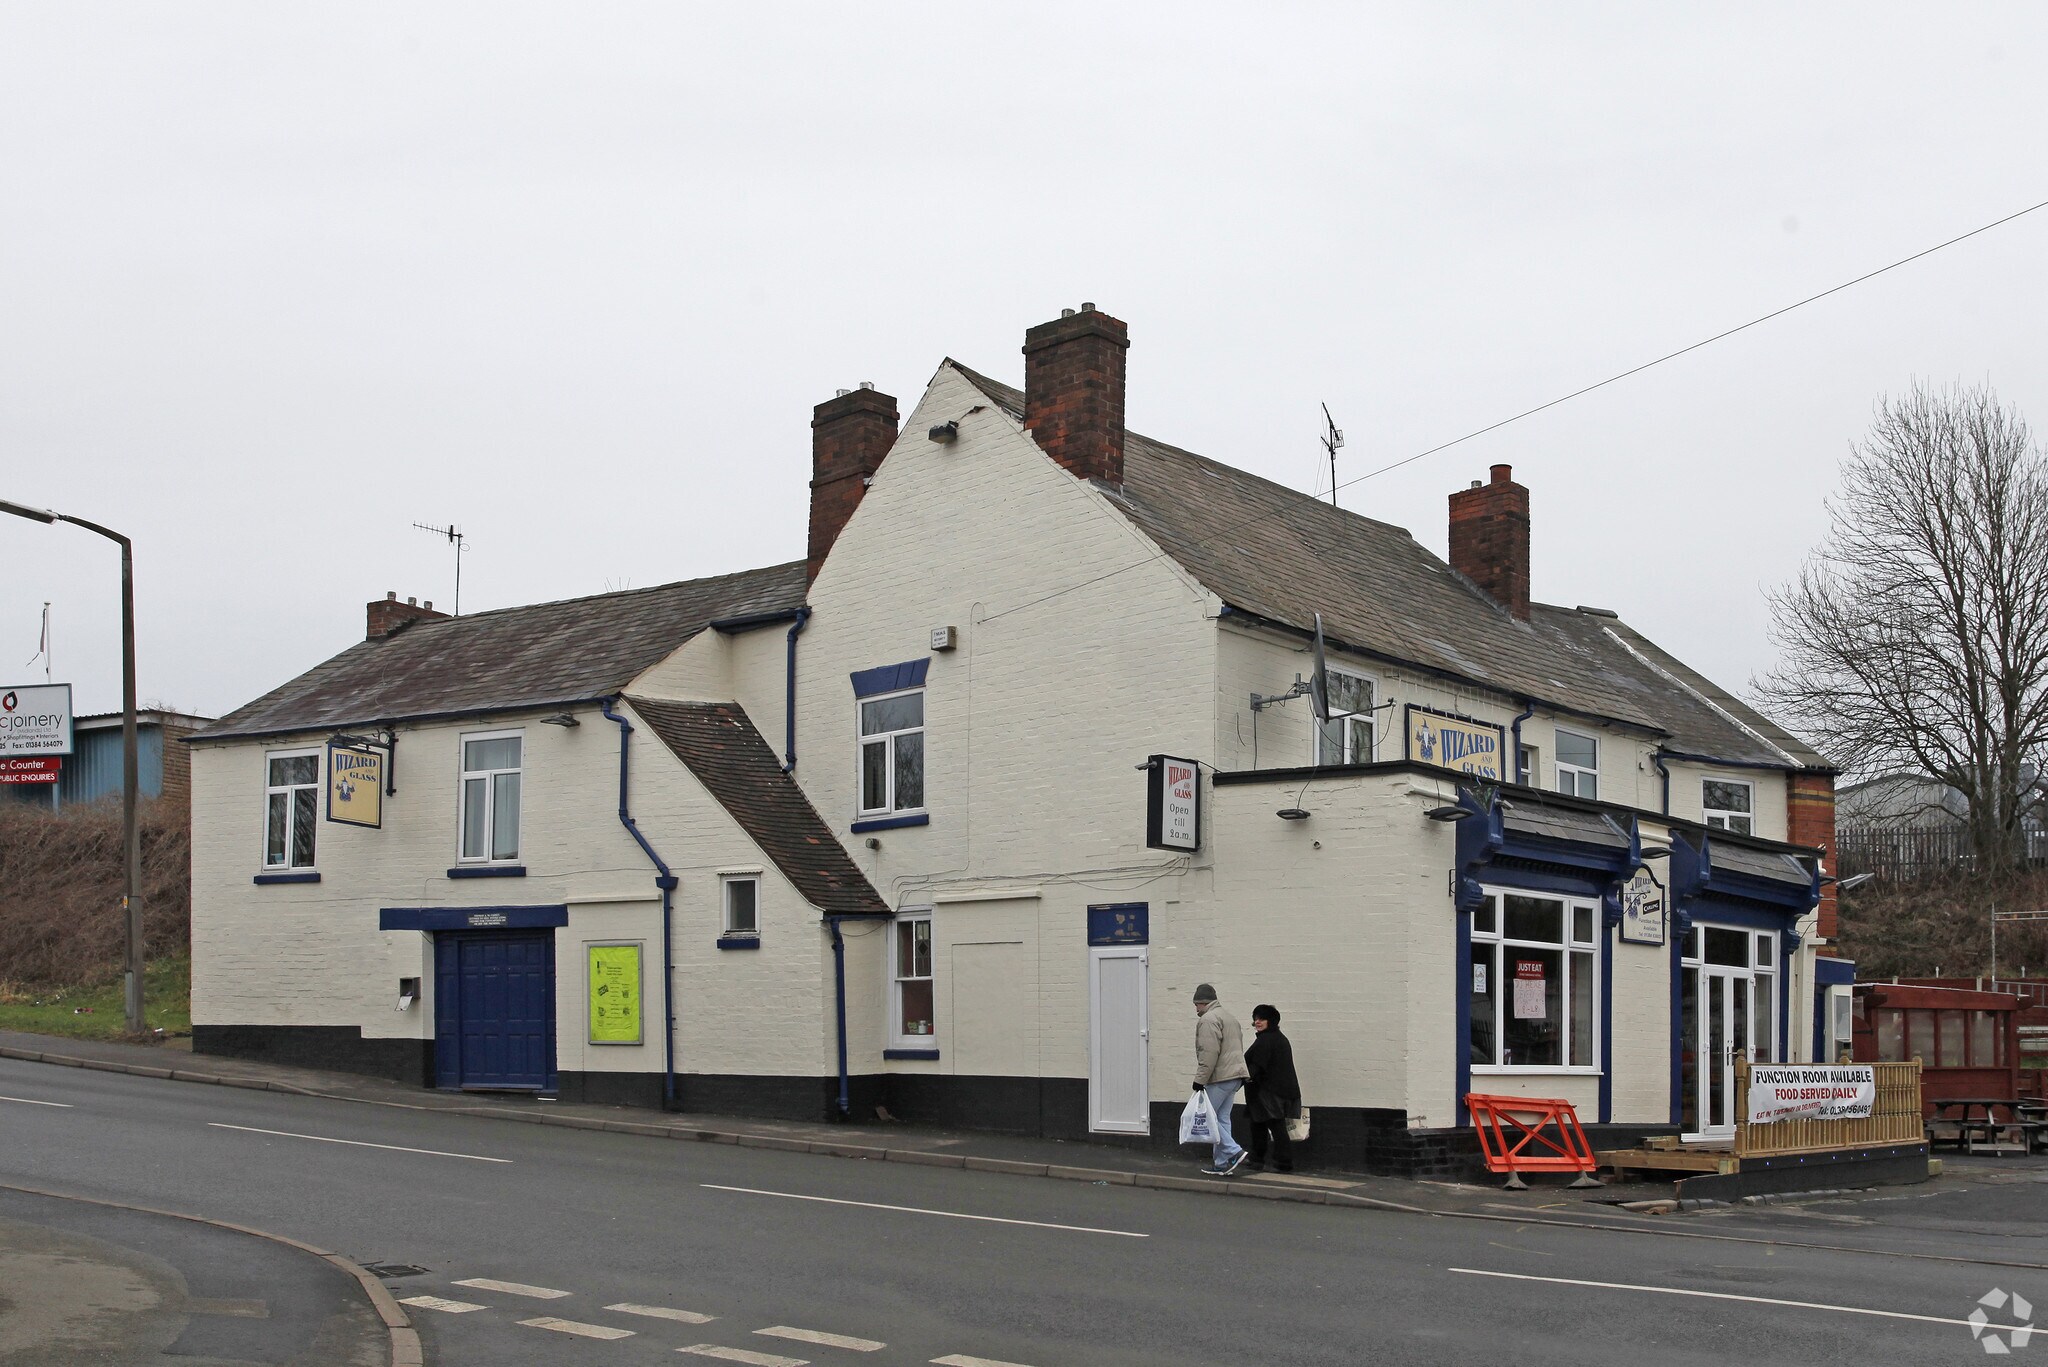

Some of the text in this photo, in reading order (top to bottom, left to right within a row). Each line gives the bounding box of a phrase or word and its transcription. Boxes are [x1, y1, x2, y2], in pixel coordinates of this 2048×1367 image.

[1440, 729, 1495, 767] WIZARD
[10, 760, 45, 770] Counter
[336, 754, 376, 774] WIZARD
[350, 772, 376, 782] GLASS
[1462, 762, 1496, 780] GLASS
[1168, 766, 1192, 789] WIZARD
[1174, 788, 1192, 800] GLASS
[1170, 804, 1188, 814] Open
[1174, 818, 1184, 827] till
[1518, 963, 1542, 972] JUST EAT
[1756, 1070, 1872, 1084] FUNCTION ROOM AVAILABLE
[1776, 1088, 1857, 1100] FOOD SERVED DAILY
[1756, 1111, 1765, 1120] EAT
